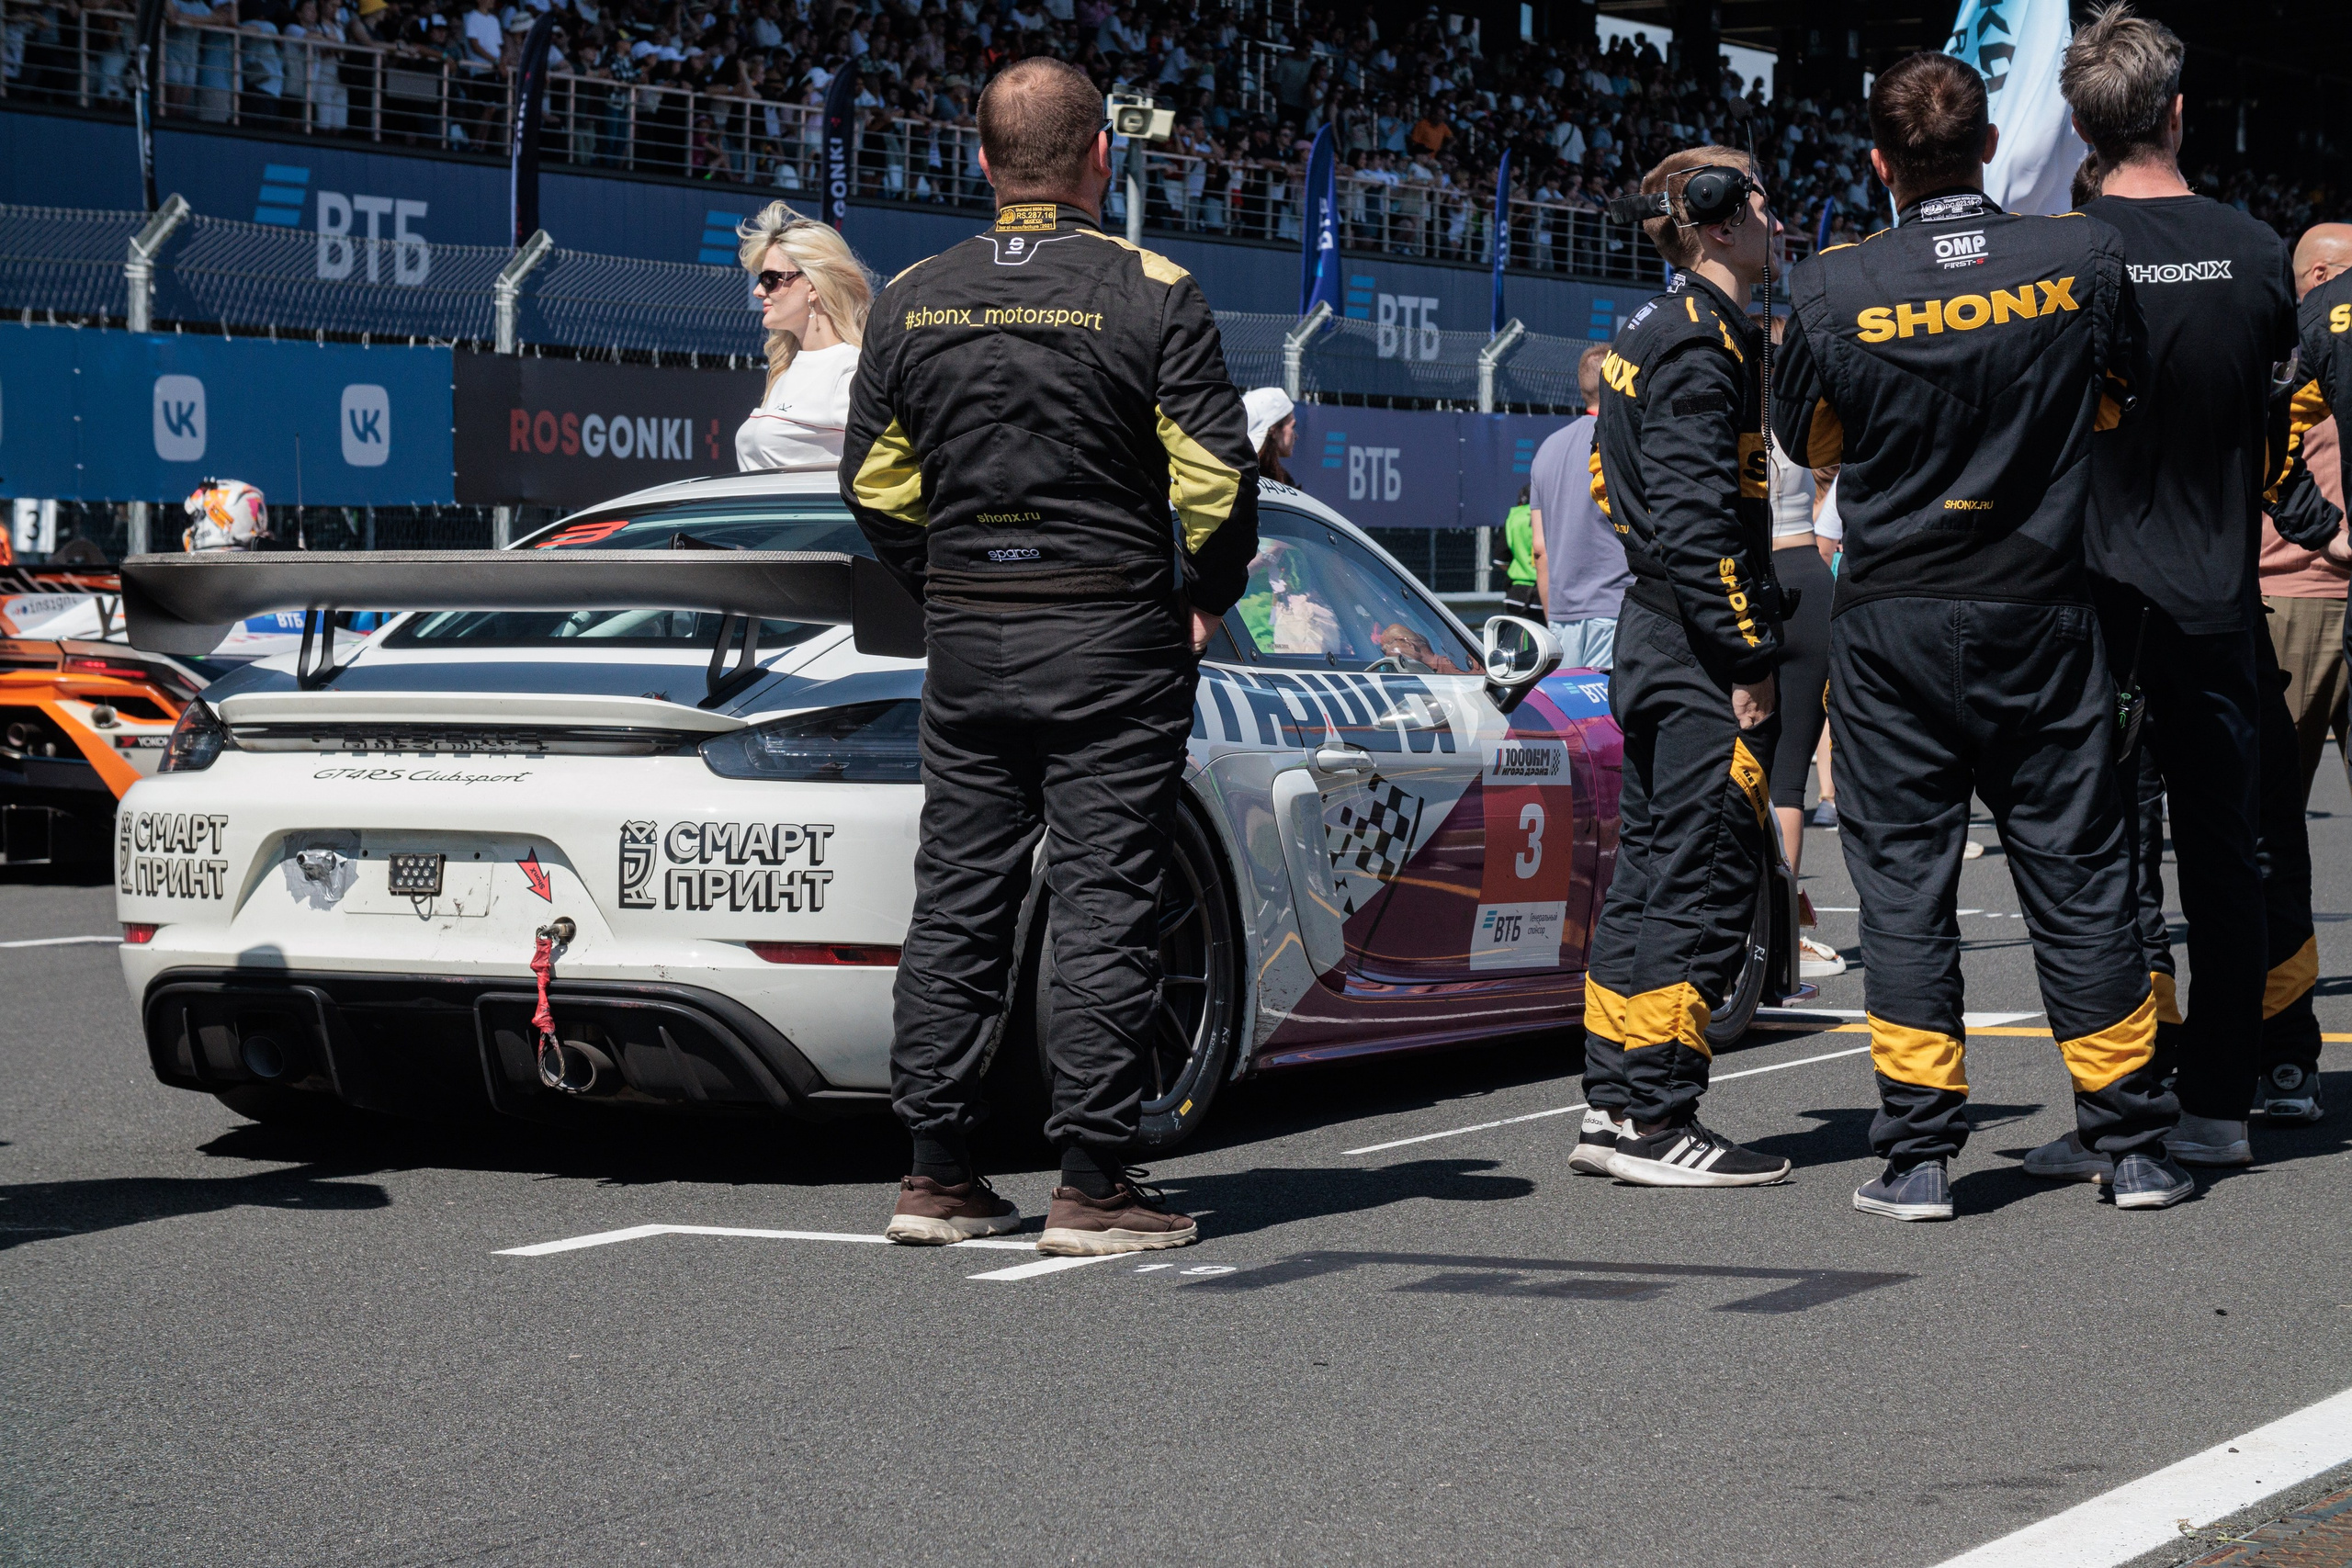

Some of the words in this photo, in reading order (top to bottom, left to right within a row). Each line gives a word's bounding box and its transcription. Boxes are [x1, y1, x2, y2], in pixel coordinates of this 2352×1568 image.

[316, 190, 431, 285] ВТБ
[1935, 235, 1985, 257] OMP
[1944, 257, 1984, 269] FIRST-S
[905, 306, 1103, 331] #shonx_motorsport
[1377, 294, 1440, 361] ВТБ
[1856, 276, 2080, 343] SHONX
[509, 409, 693, 459] ROSGONKI
[1349, 446, 1401, 502] ВТБ
[977, 512, 1041, 524] shonx.ru
[1944, 499, 1994, 511] SHONX.RU
[26, 510, 40, 540] 3
[988, 548, 1041, 562] sparco
[277, 613, 304, 627] ВТБ
[1719, 558, 1761, 648] SHONX
[408, 770, 533, 785] Clubsport
[135, 811, 229, 854] СМАРТ
[664, 821, 834, 865] СМАРТ
[1514, 803, 1545, 879] 3
[135, 856, 228, 900] ПРИНТ
[664, 868, 834, 912] ПРИНТ
[1494, 915, 1522, 942] ВТБ
[1584, 1117, 1603, 1126] adidas
